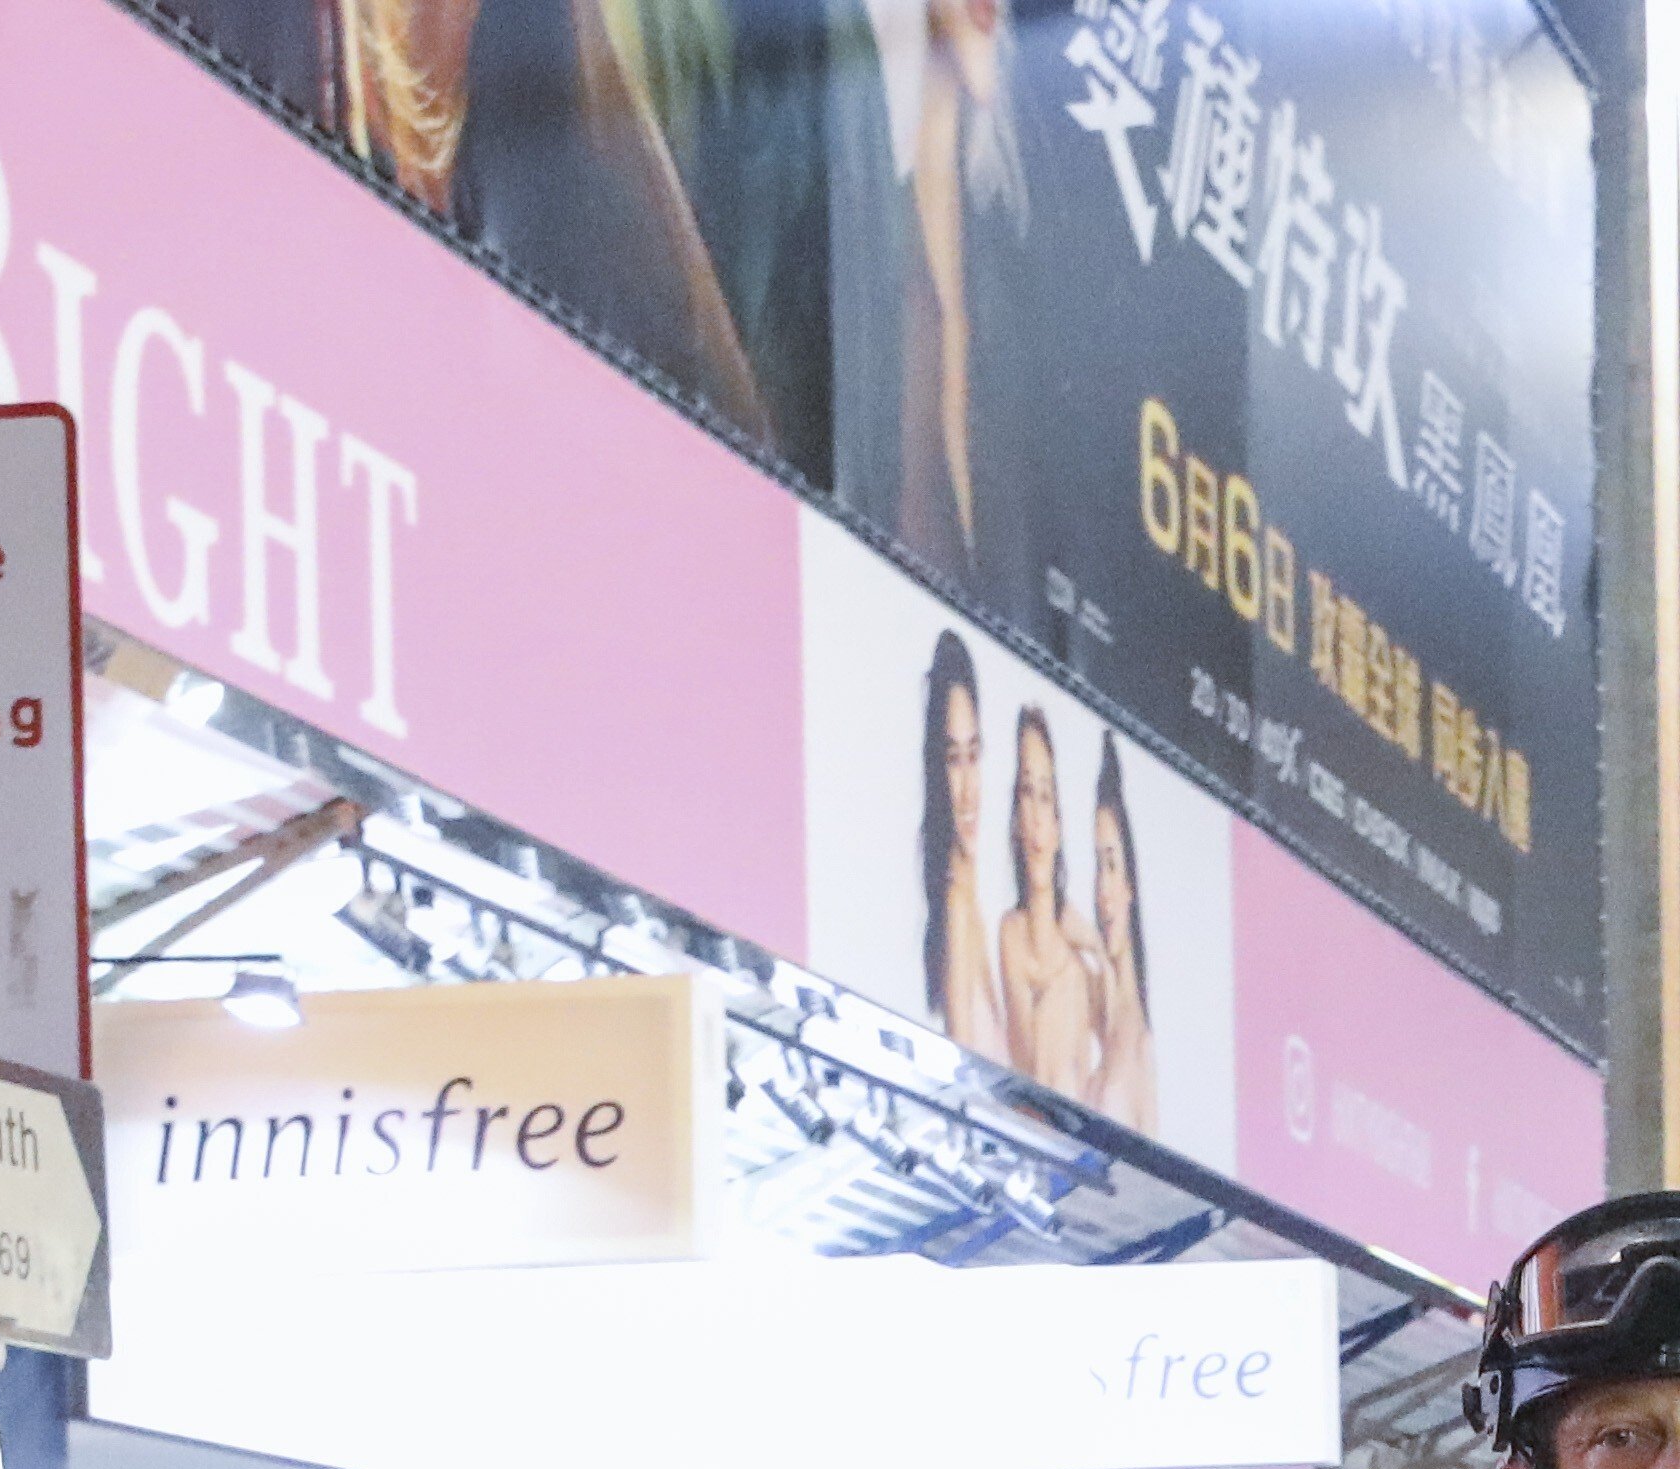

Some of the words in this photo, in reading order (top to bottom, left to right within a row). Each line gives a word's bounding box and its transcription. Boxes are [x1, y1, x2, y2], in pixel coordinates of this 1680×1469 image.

[1140, 397, 1296, 655] 6月6日
[154, 1077, 629, 1185] innisfree
[1091, 1333, 1273, 1400] free
